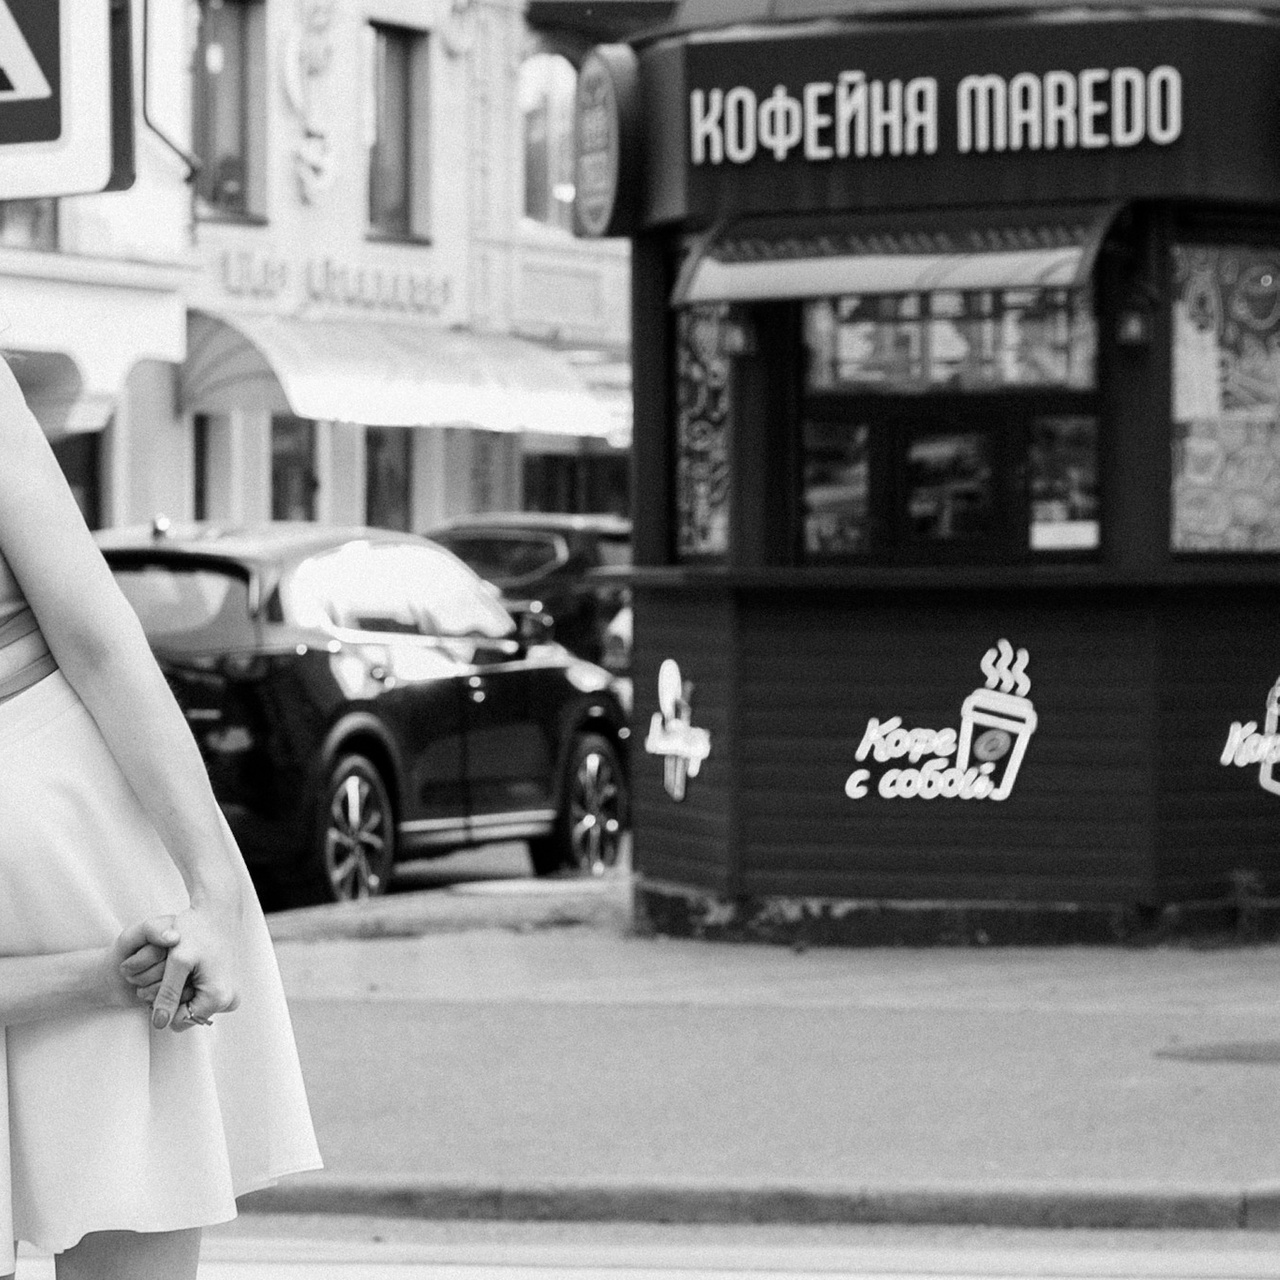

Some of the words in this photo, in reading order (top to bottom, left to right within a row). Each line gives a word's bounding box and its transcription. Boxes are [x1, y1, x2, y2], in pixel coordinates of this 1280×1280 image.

[690, 70, 939, 165] КОФЕЙНЯ
[956, 65, 1183, 154] MAREDO
[854, 716, 957, 763] Кофе
[845, 769, 870, 799] с
[878, 758, 996, 800] собой
